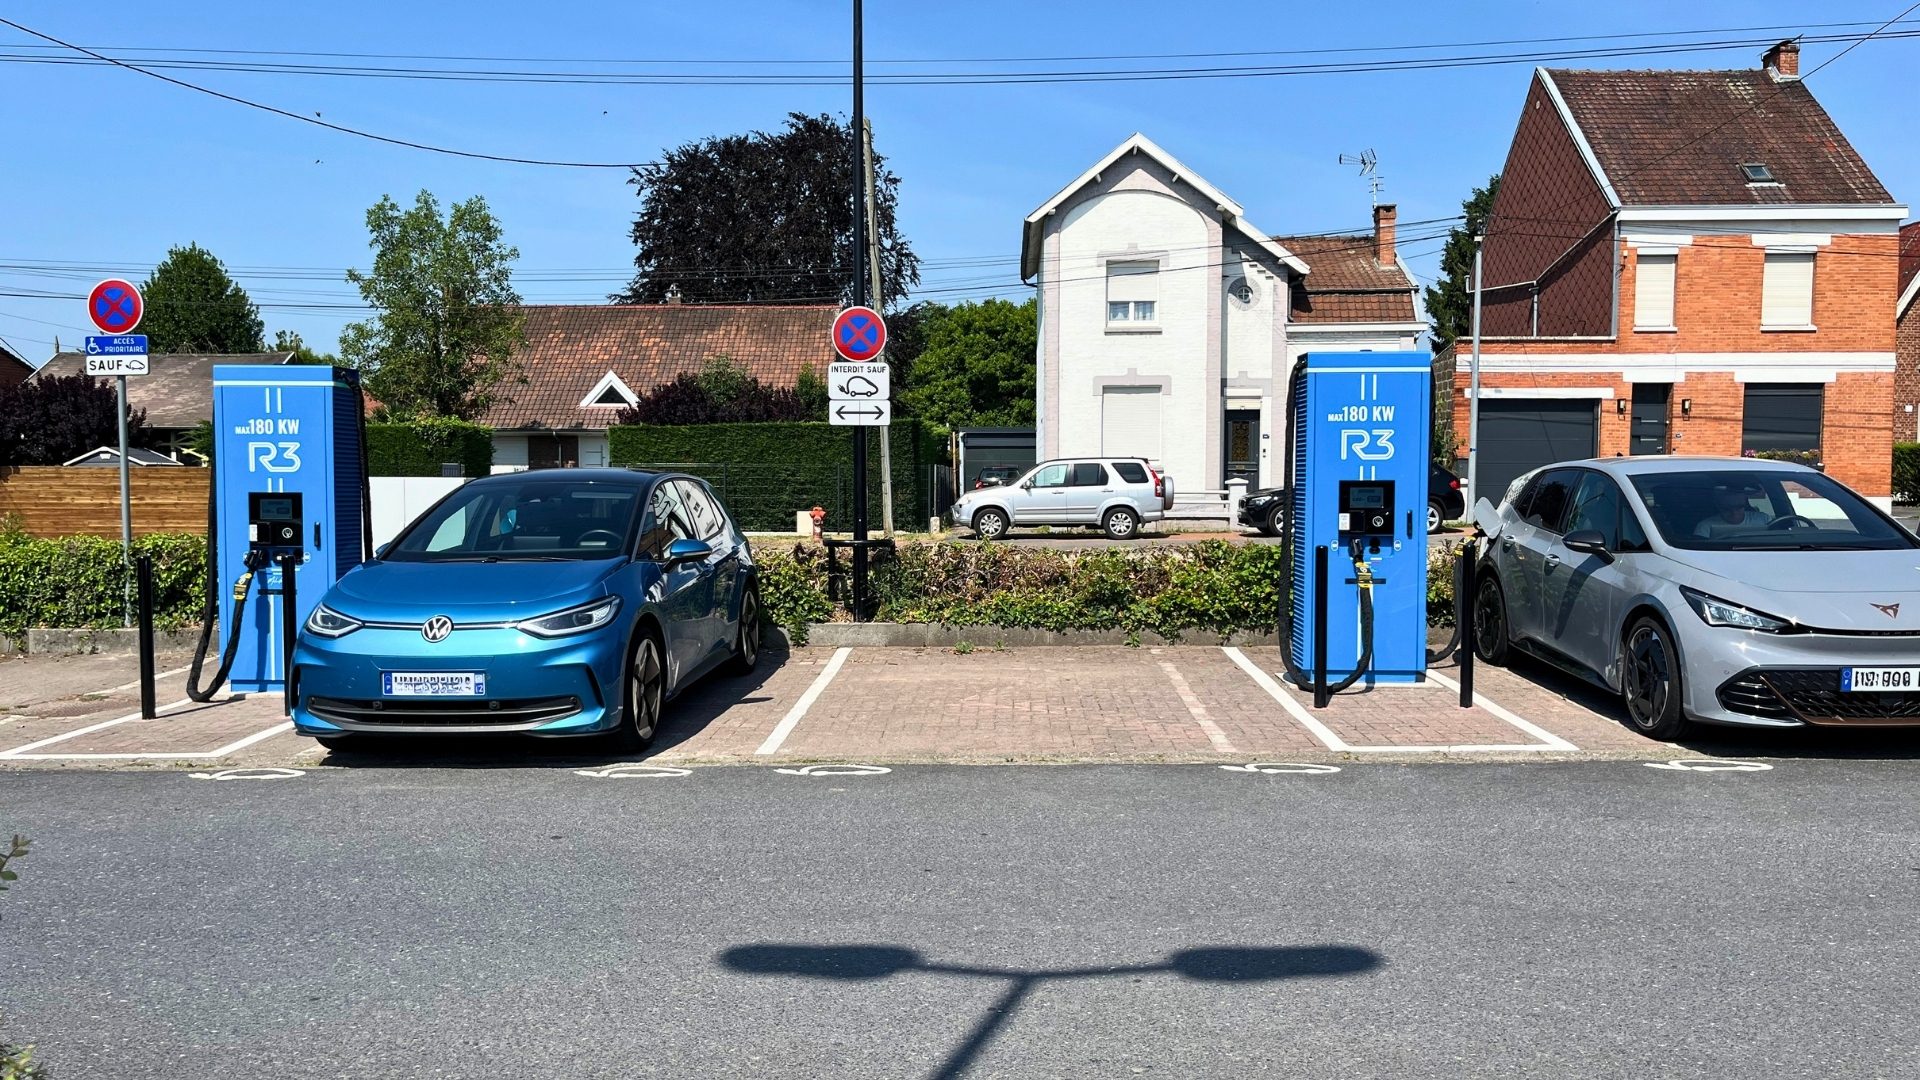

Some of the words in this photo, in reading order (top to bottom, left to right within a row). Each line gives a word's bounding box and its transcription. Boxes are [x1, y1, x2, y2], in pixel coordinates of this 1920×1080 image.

[89, 360, 123, 371] SAUF
[1372, 405, 1395, 422] KW
[278, 418, 300, 435] KW
[1341, 429, 1395, 460] R3
[248, 441, 302, 473] R3
